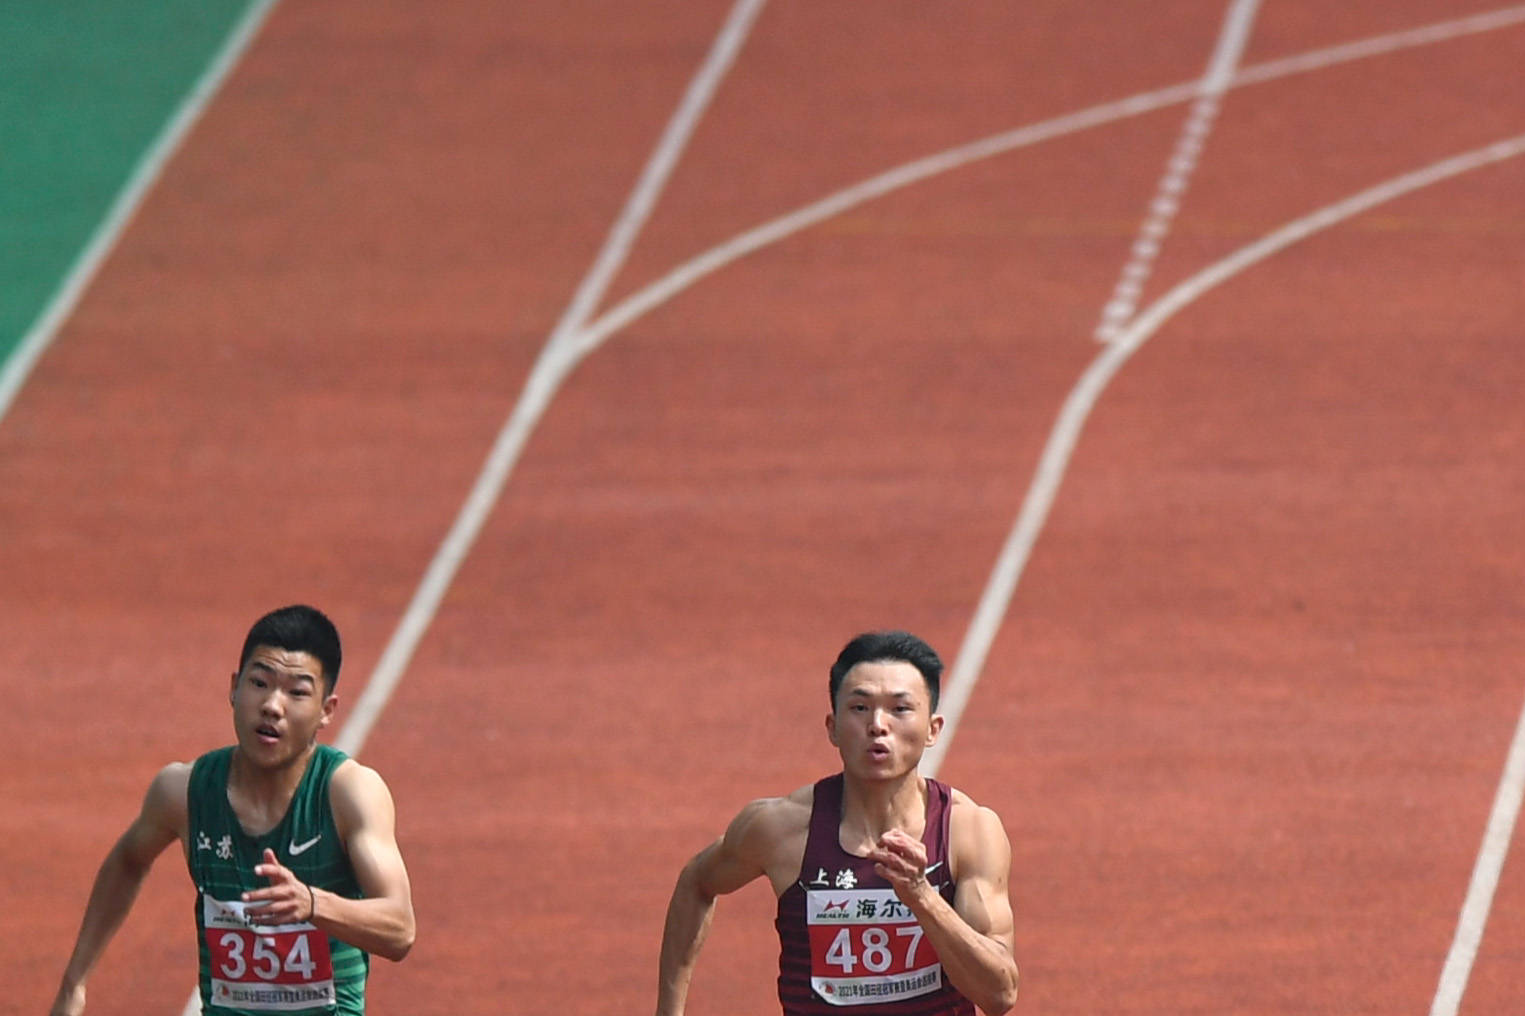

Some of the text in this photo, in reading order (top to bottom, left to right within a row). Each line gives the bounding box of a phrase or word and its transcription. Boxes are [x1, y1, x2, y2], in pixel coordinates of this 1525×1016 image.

[809, 867, 858, 890] 上海
[856, 898, 914, 919] 海尔
[219, 931, 316, 980] 354
[825, 927, 925, 974] 487
